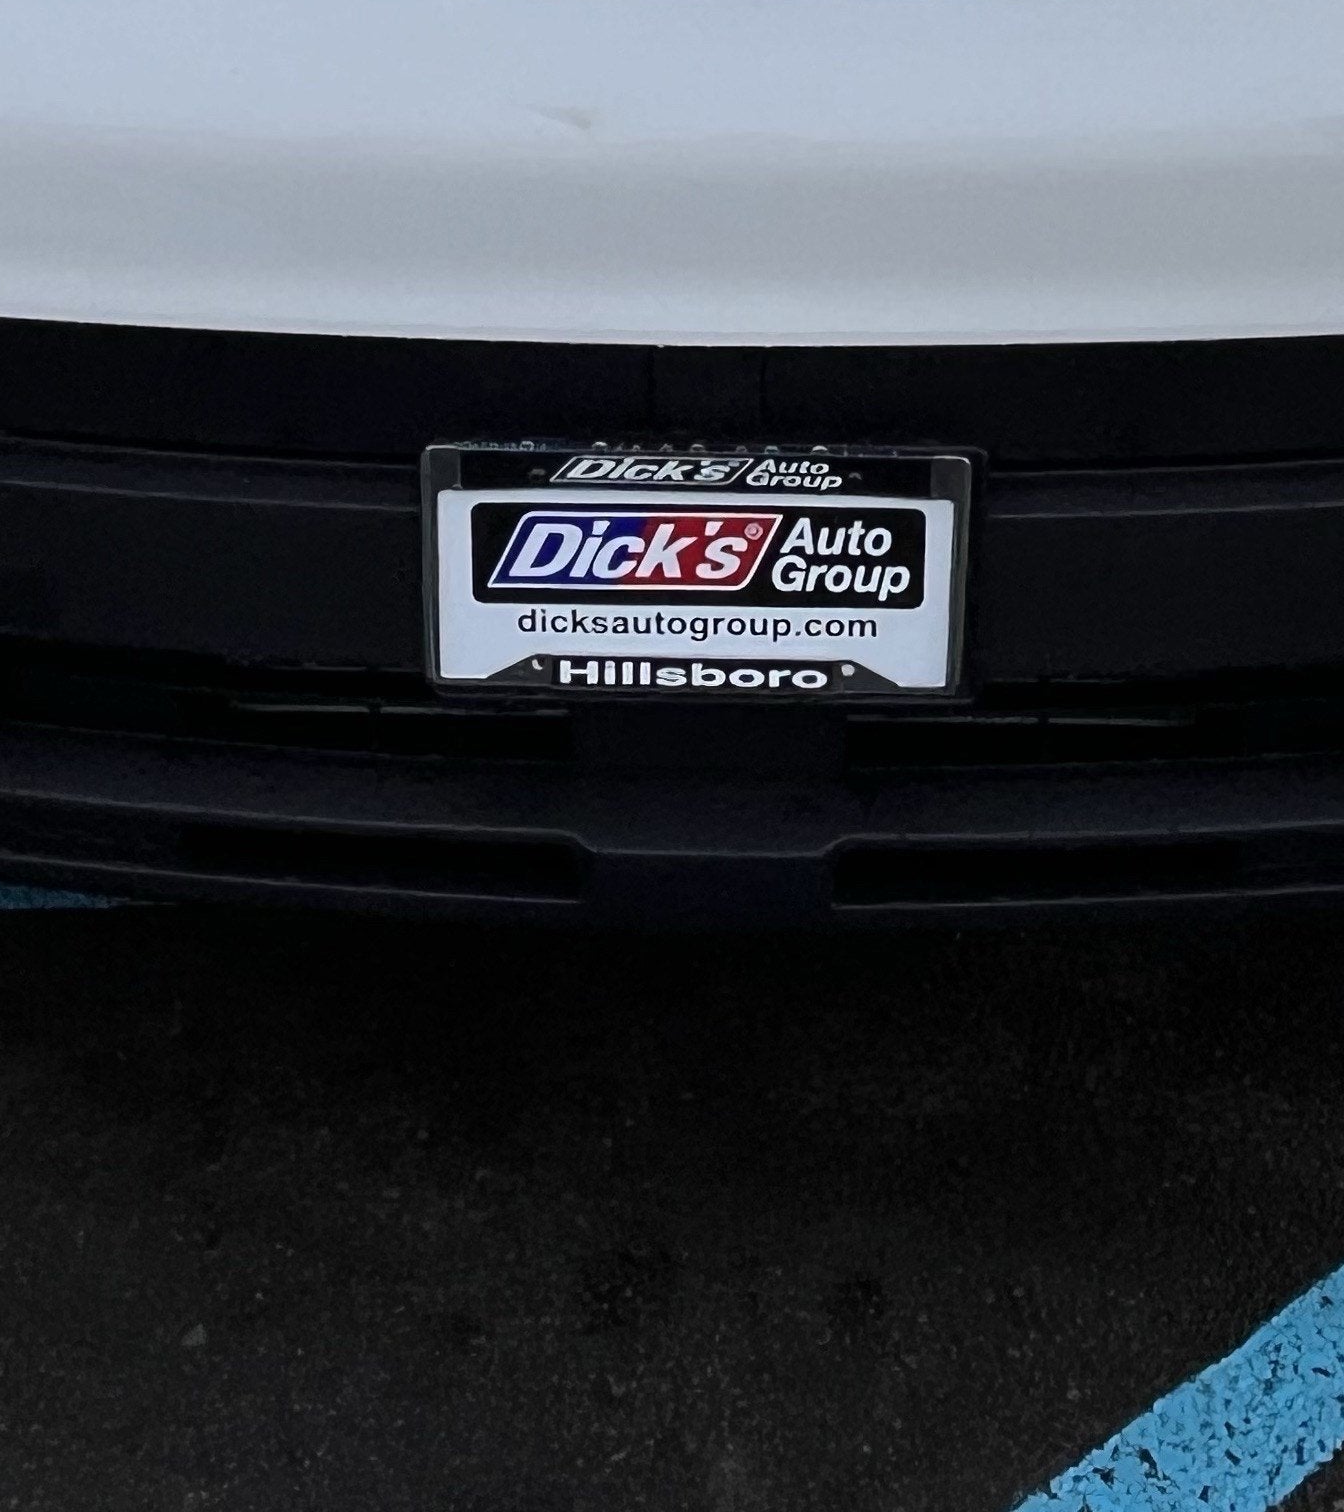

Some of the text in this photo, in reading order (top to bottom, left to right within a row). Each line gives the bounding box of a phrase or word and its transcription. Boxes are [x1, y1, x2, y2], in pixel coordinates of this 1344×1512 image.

[566, 457, 732, 481] Dick's
[745, 471, 843, 491] Group
[757, 458, 830, 475] Auto
[507, 520, 747, 579] Dick's
[778, 517, 892, 557] Auto
[771, 555, 911, 601] Group
[517, 608, 879, 641] dicksautogroup.com
[557, 660, 828, 689] Hillsboro
